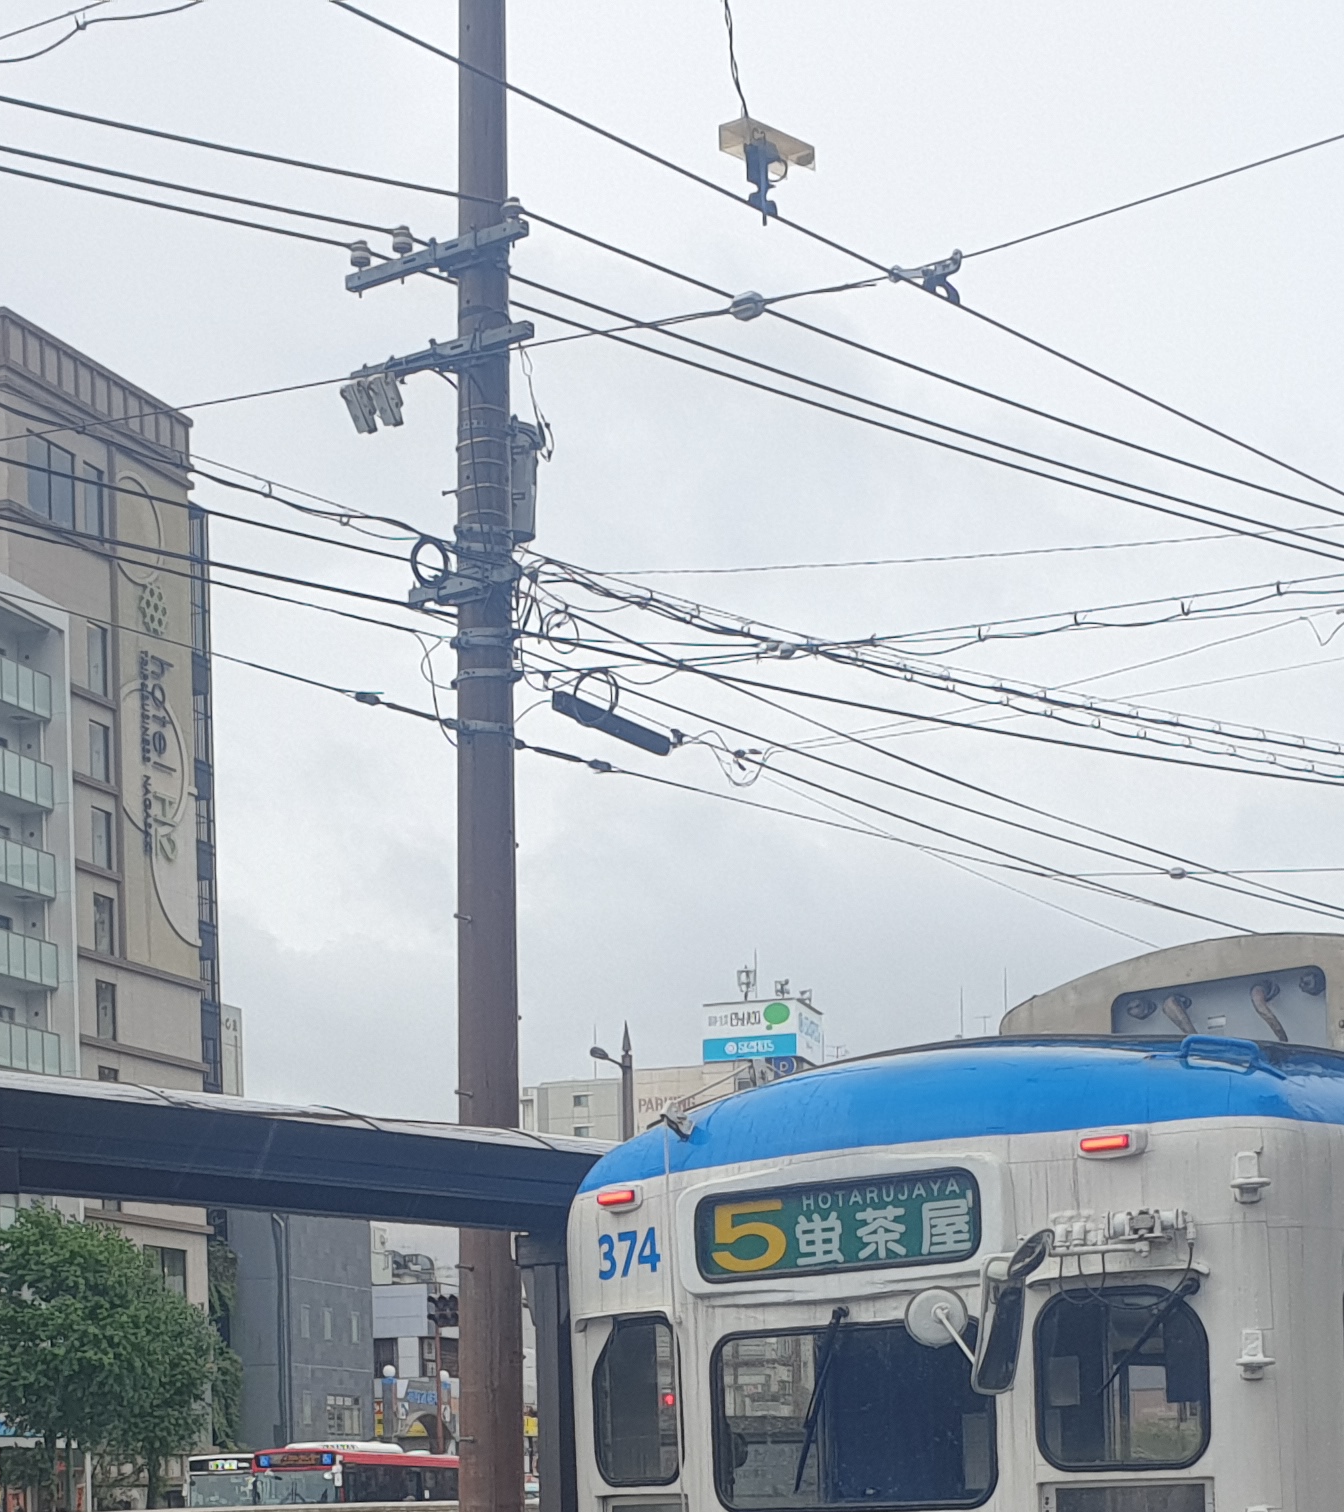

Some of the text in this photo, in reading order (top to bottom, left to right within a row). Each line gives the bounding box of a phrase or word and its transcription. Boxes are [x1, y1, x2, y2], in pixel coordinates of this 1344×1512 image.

[152, 655, 178, 863] hotel H2
[795, 1190, 972, 1266] 蛍茶屋
[802, 1177, 961, 1211] HOTARUJAYA
[598, 1226, 661, 1281] 374
[711, 1199, 787, 1273] 5
